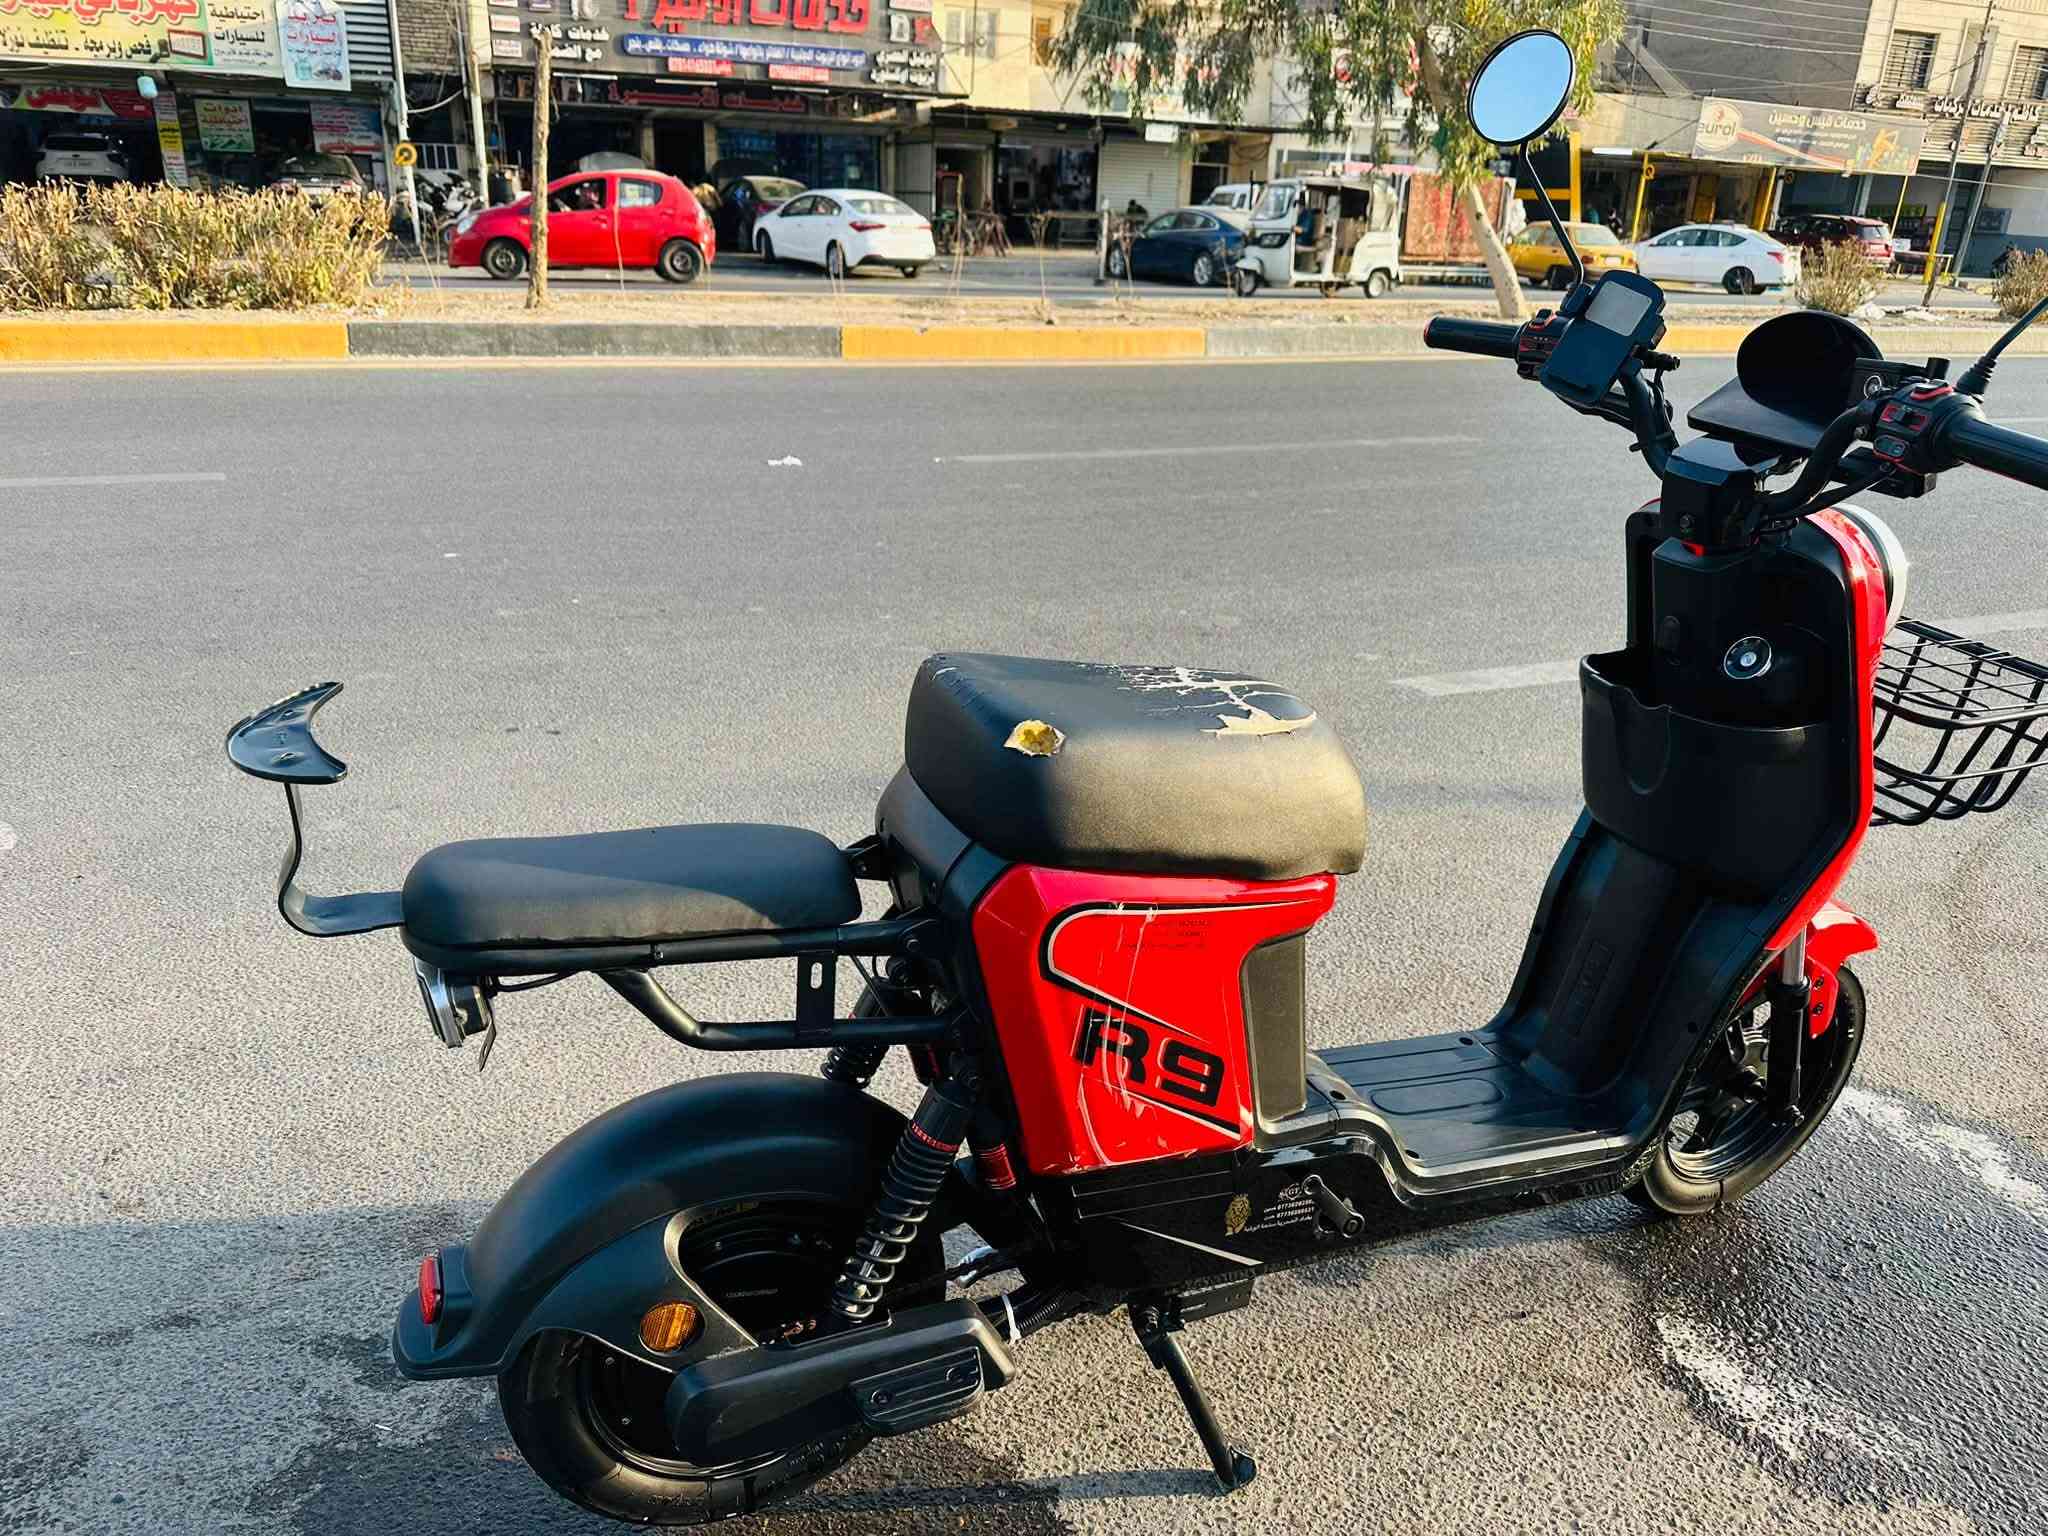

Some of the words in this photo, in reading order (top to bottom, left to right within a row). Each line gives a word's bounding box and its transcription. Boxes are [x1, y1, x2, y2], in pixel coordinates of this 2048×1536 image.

[214, 26, 265, 46] للسيارات
[567, 26, 609, 41] خدمات
[584, 47, 602, 62] مع
[1833, 115, 1867, 131] خدمات
[1073, 1006, 1226, 1108] R9
